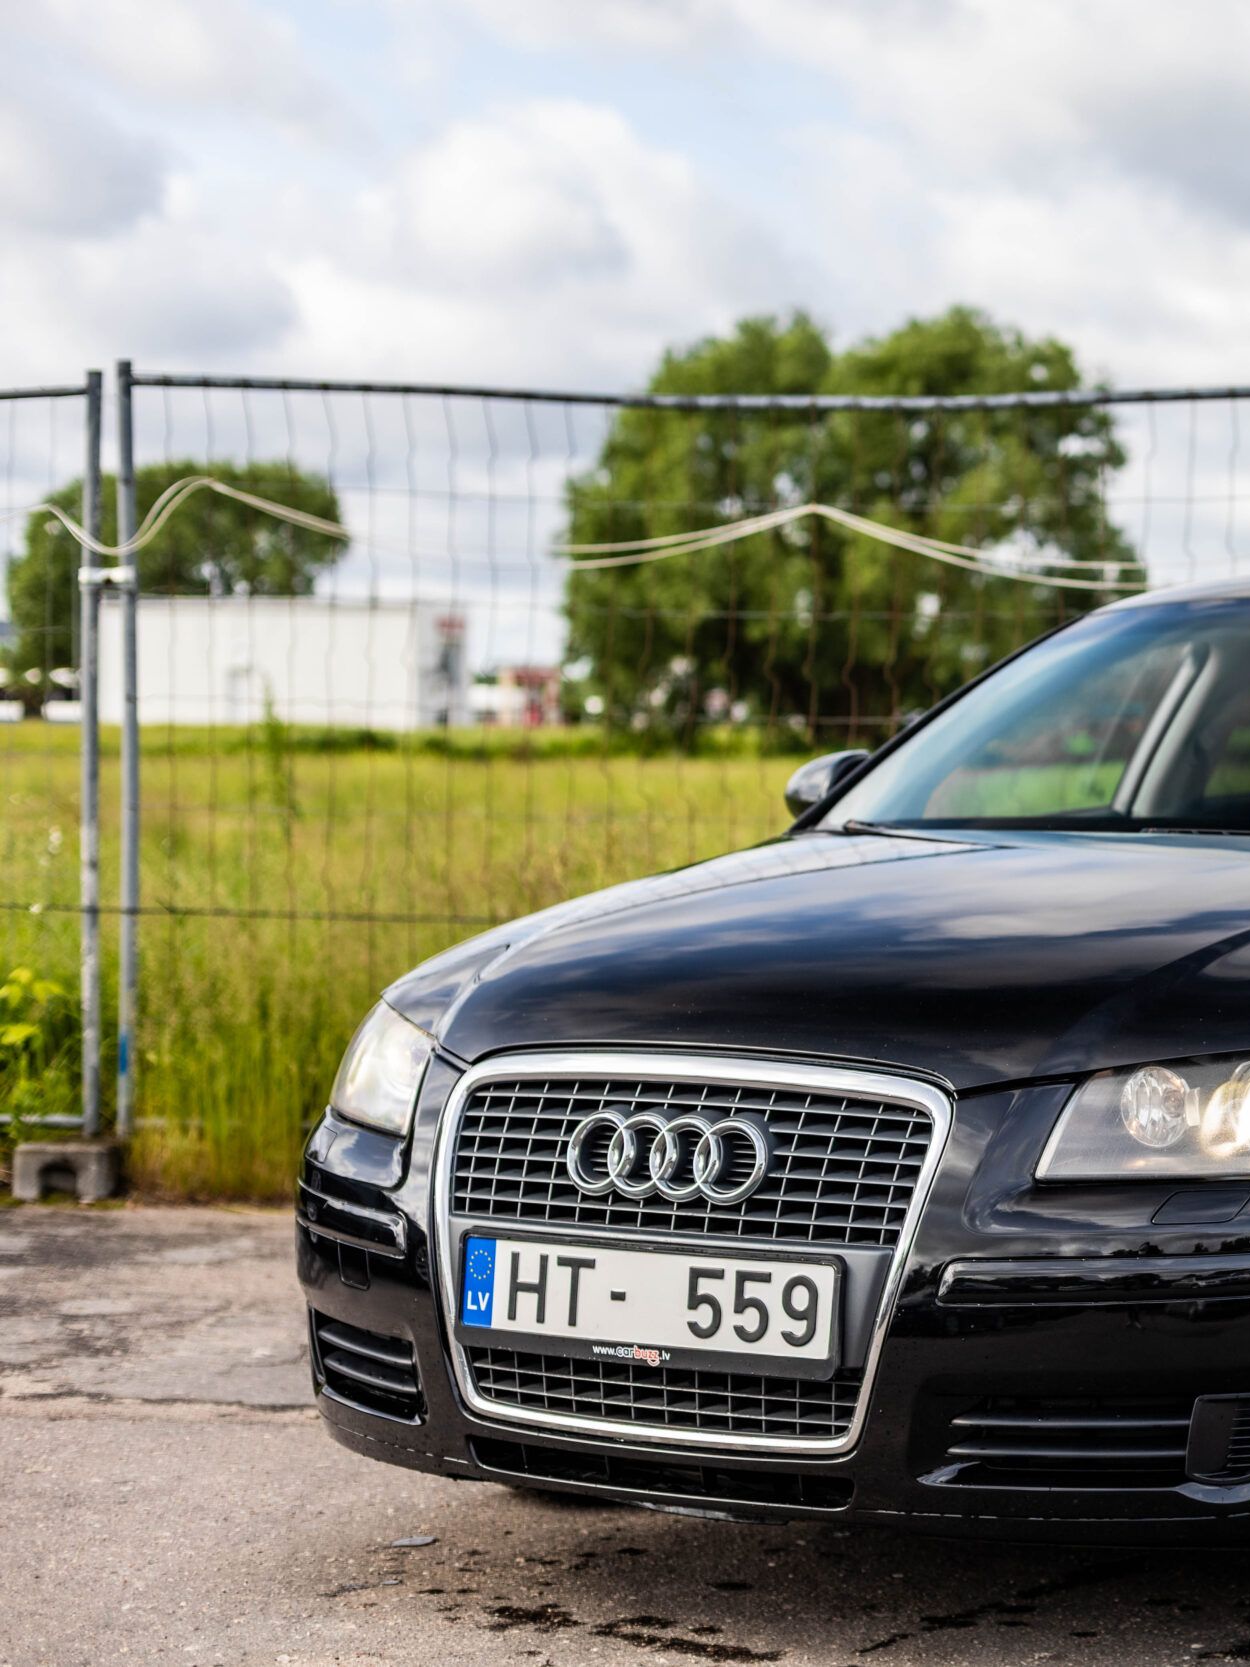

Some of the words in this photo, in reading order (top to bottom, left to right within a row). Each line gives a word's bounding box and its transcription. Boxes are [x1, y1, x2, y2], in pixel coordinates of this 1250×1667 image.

[466, 1290, 490, 1311] LV
[687, 1266, 818, 1347] 559
[592, 1344, 671, 1362] www.carbuzz.lv
